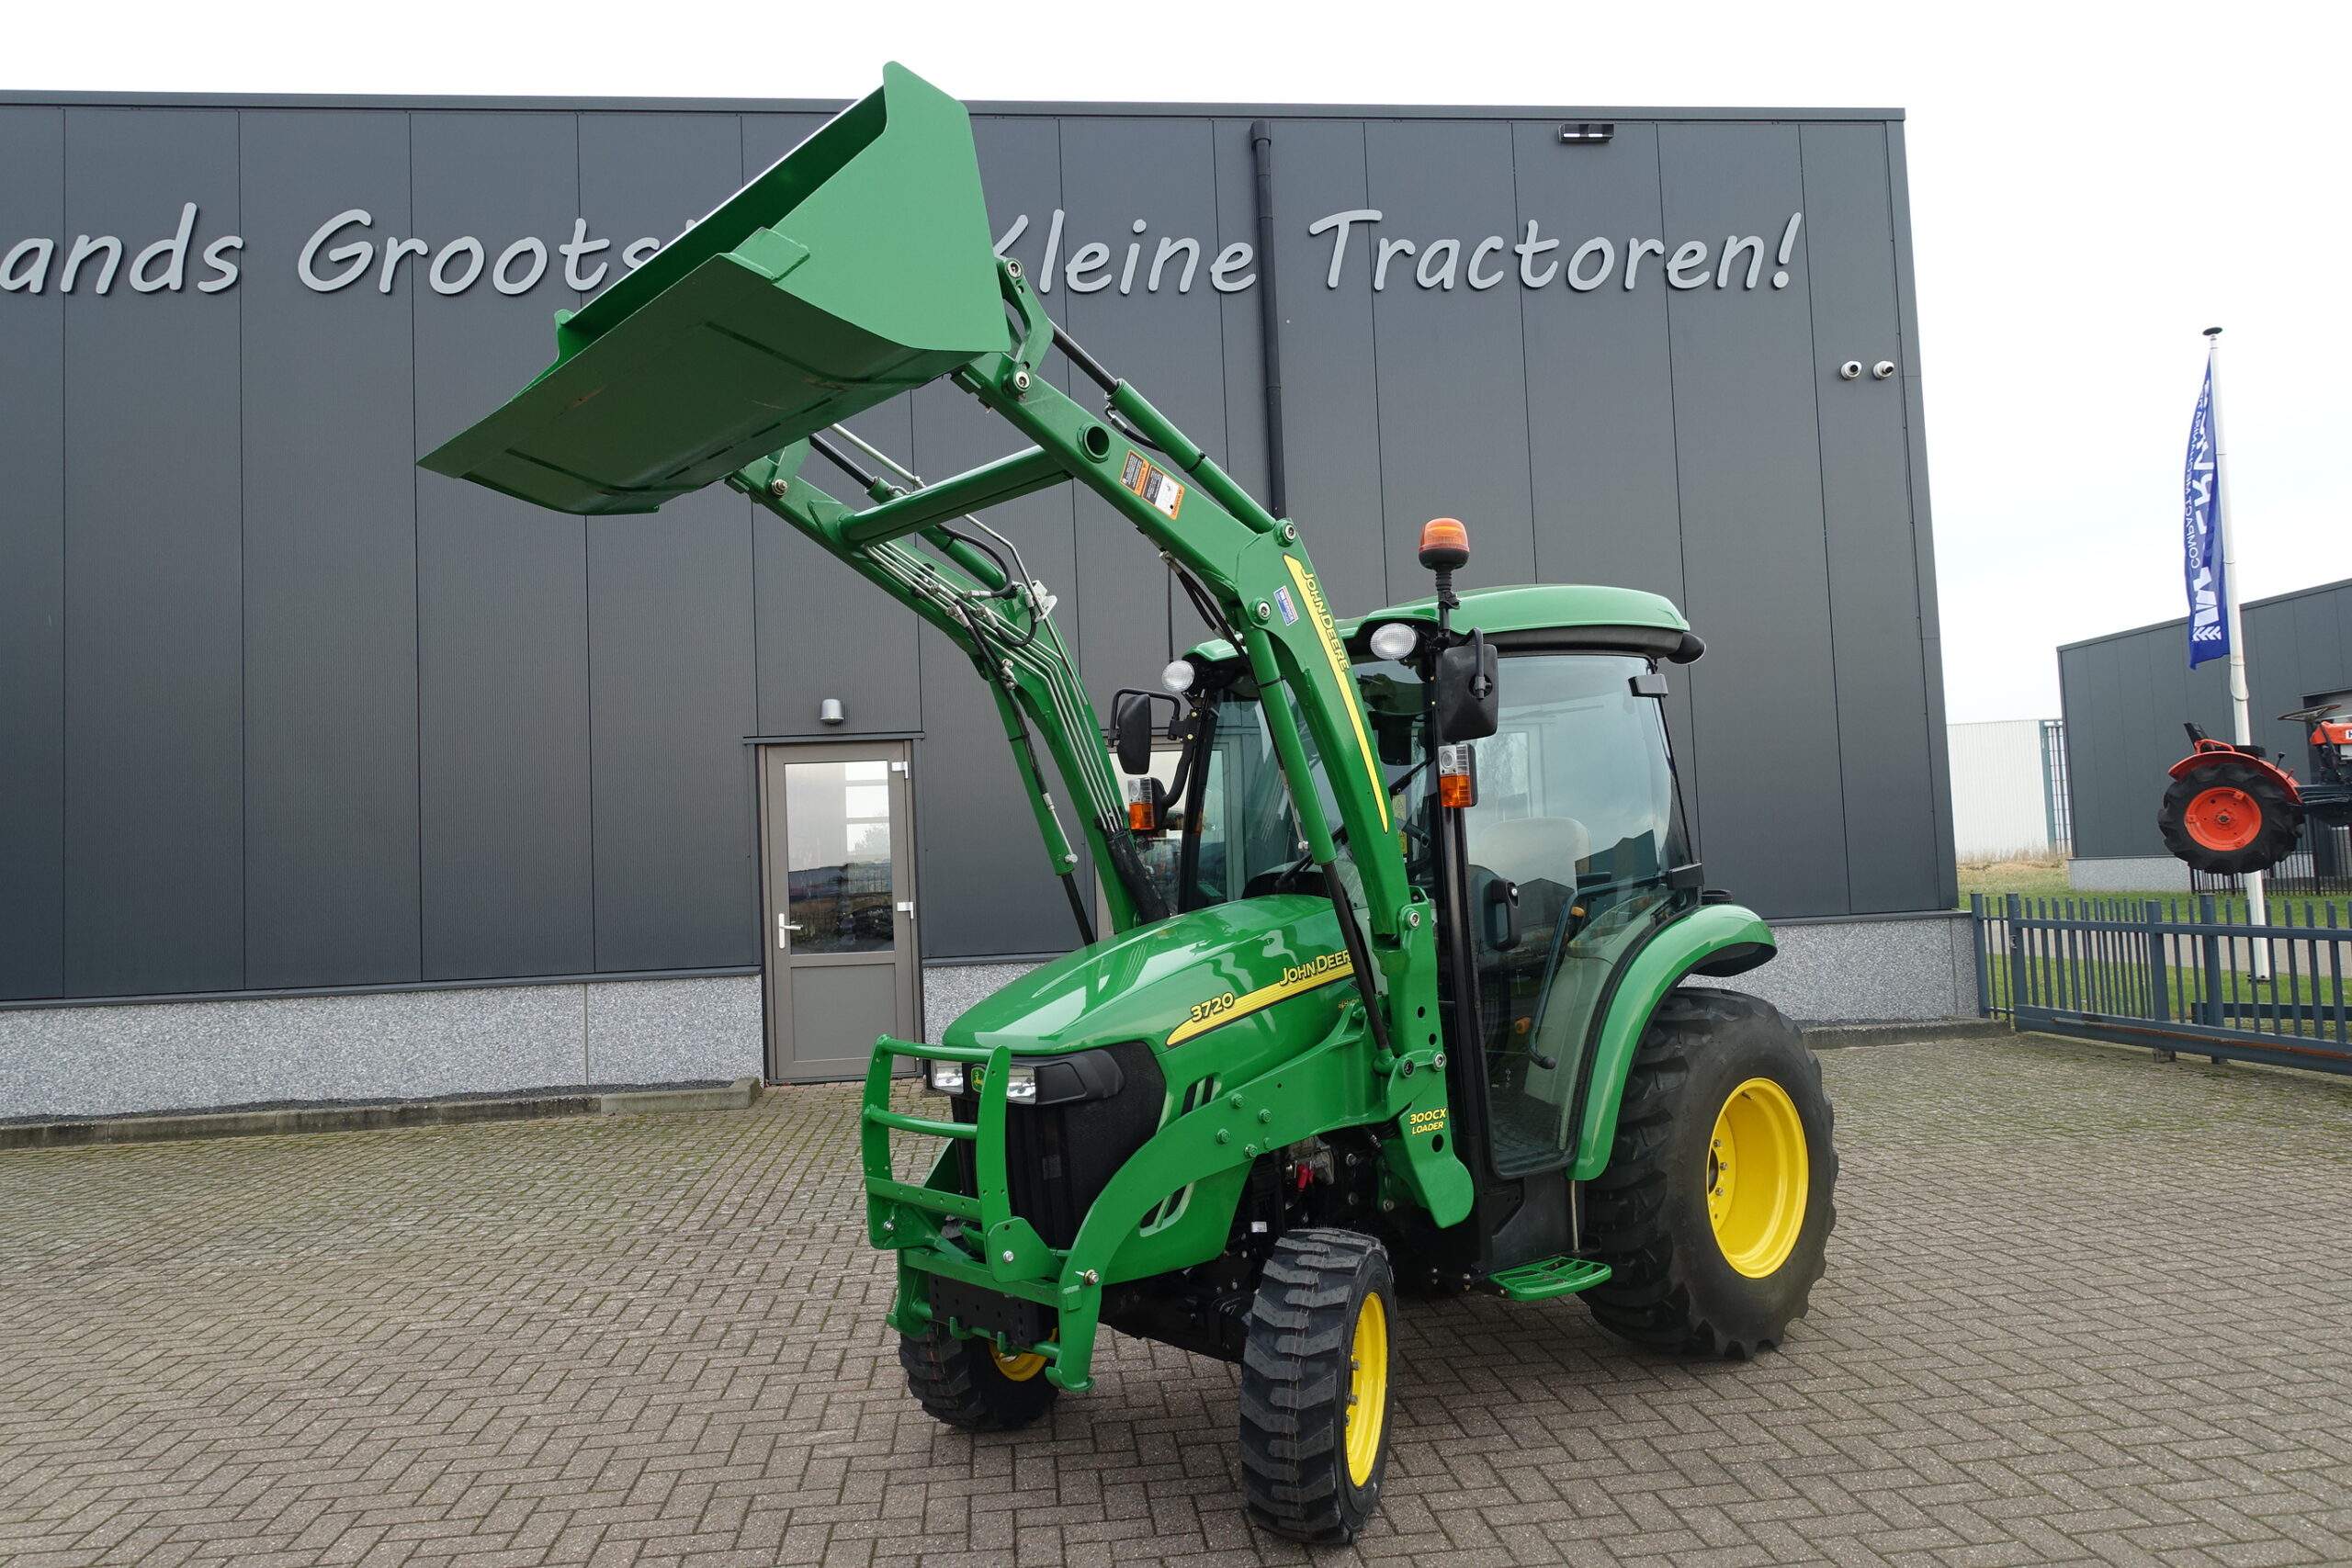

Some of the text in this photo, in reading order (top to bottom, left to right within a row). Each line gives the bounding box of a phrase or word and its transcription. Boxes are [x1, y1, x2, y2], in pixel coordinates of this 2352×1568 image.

[0, 202, 243, 294] ands
[298, 209, 695, 295] Groots
[1309, 209, 1801, 291] Tractoren!
[1301, 568, 1351, 671] JOHN DEERE
[1280, 949, 1351, 986] JOHN DEER
[1191, 992, 1235, 1022] 3720
[1409, 1108, 1448, 1125] 300CX
[1411, 1121, 1444, 1135] LOADER
